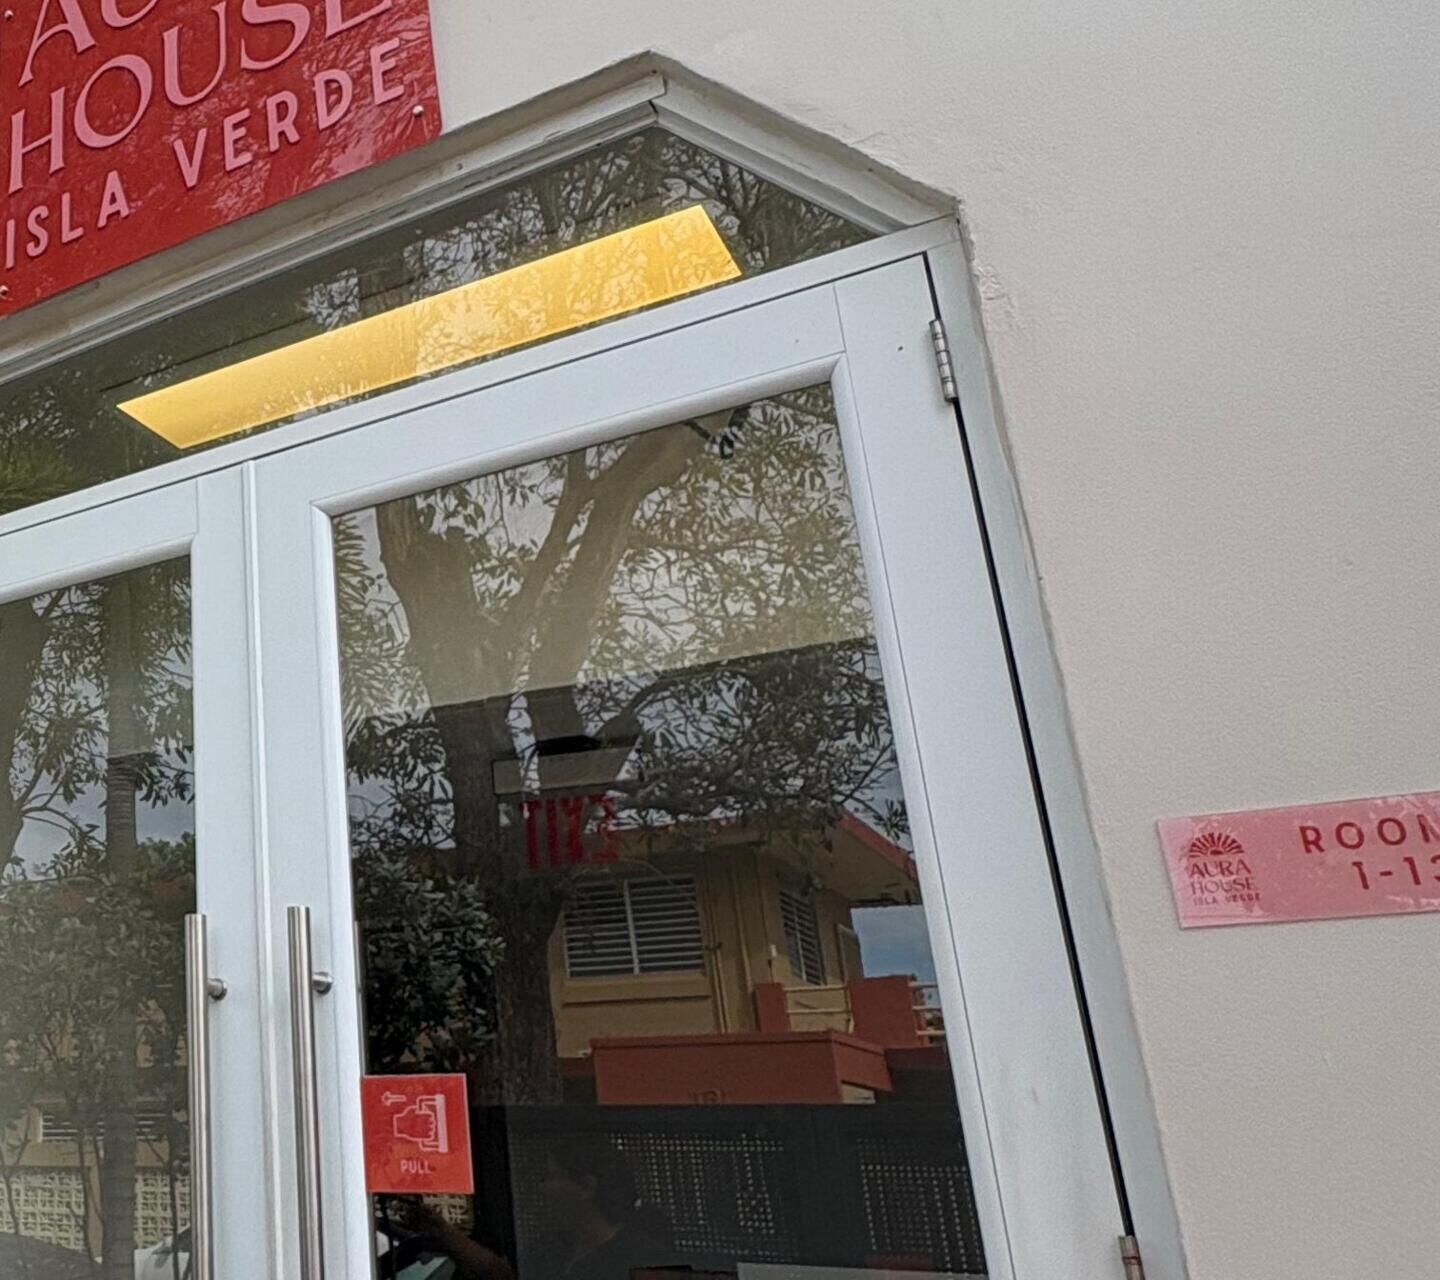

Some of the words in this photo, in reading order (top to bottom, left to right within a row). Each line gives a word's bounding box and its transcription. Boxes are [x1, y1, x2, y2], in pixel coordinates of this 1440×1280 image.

[4, 170, 131, 269] ISLA
[172, 37, 406, 188] VERDE
[1189, 859, 1252, 879] AURA
[1190, 877, 1256, 895] HOUSE
[400, 1159, 432, 1174] PULL
